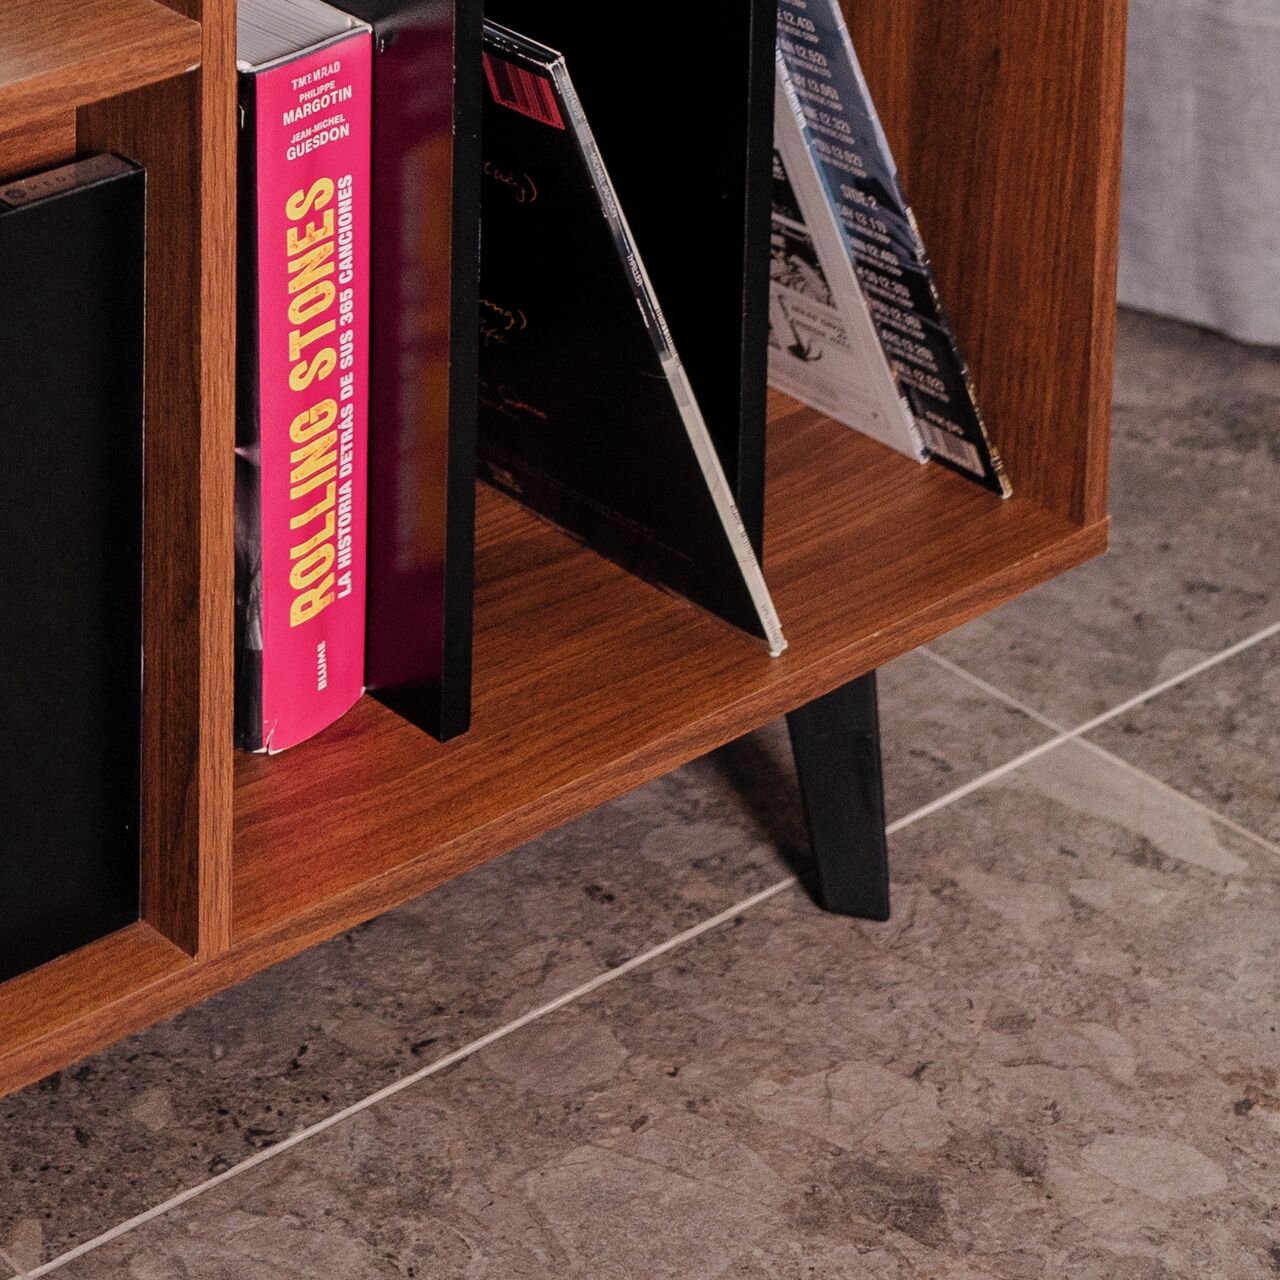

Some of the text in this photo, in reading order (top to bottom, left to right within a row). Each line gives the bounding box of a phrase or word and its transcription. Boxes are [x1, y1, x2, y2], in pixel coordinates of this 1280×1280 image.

[282, 85, 353, 126] MARGOTIN
[299, 80, 336, 103] PHILIPPE
[286, 123, 350, 161] GUESDON
[291, 113, 346, 144] JEAN-MICHEL
[627, 252, 645, 288] THRILLER
[286, 177, 338, 628] ROLLING STONES
[337, 174, 354, 599] LA HISTORIA DETRÁS DE SUS 365 CANCIONES
[317, 640, 328, 691] BLUME
